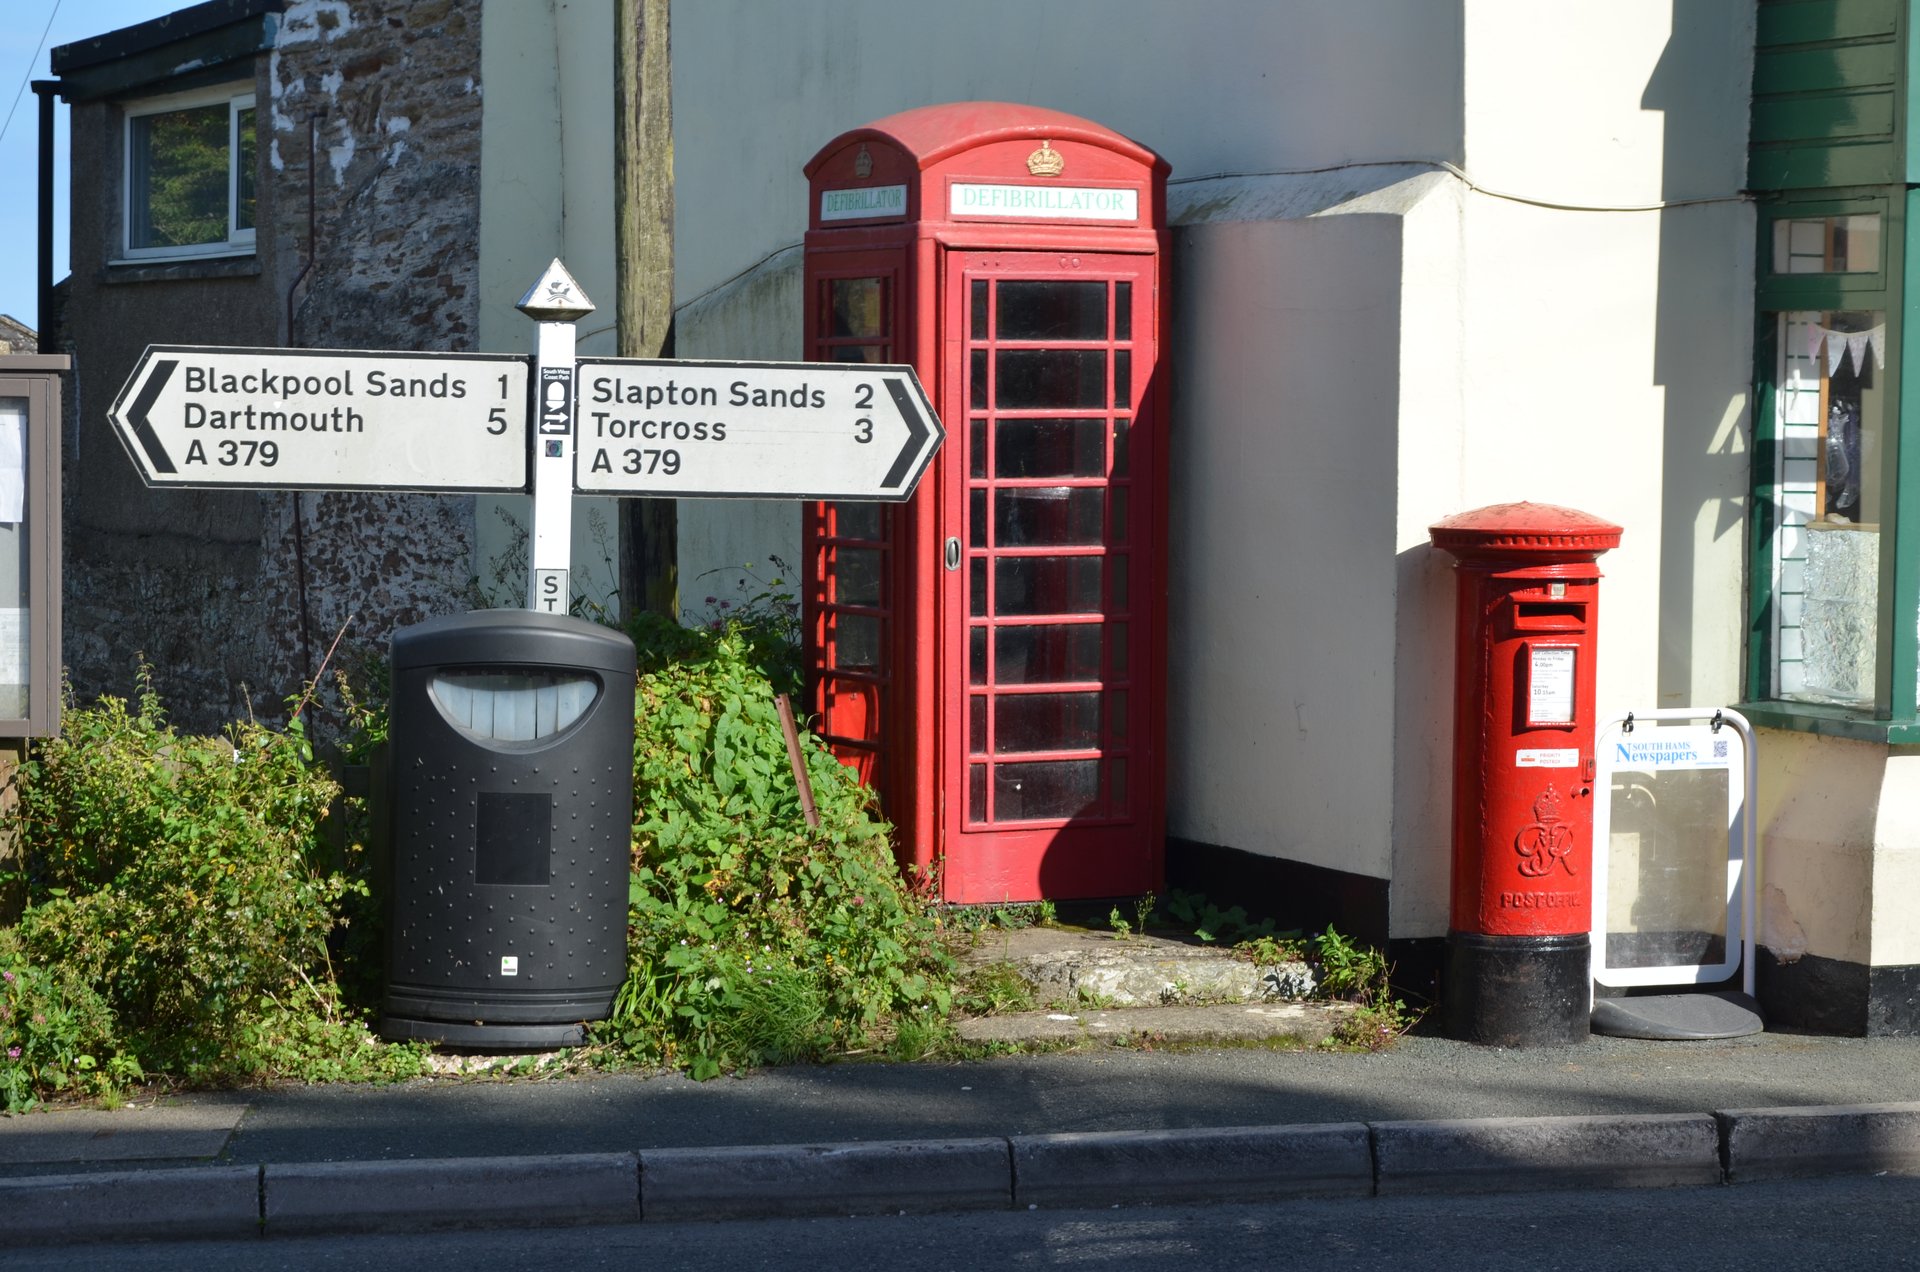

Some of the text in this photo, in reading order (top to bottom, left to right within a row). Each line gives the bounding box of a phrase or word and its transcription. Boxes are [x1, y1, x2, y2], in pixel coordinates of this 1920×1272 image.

[827, 188, 902, 212] DEFIBRILLATOR
[963, 187, 1125, 211] DEFIBRILLATOR
[185, 366, 508, 400] Blackpool Sands 1
[592, 377, 874, 410] Slapton Sands 2
[184, 402, 507, 436] Dartmouth 5
[591, 412, 873, 444] Torcross 3
[185, 439, 279, 468] A 379
[591, 448, 681, 476] A 379
[1616, 742, 1698, 765] Newspapers
[1632, 741, 1691, 751] SOUTH HAMS
[1500, 891, 1544, 908] POST
